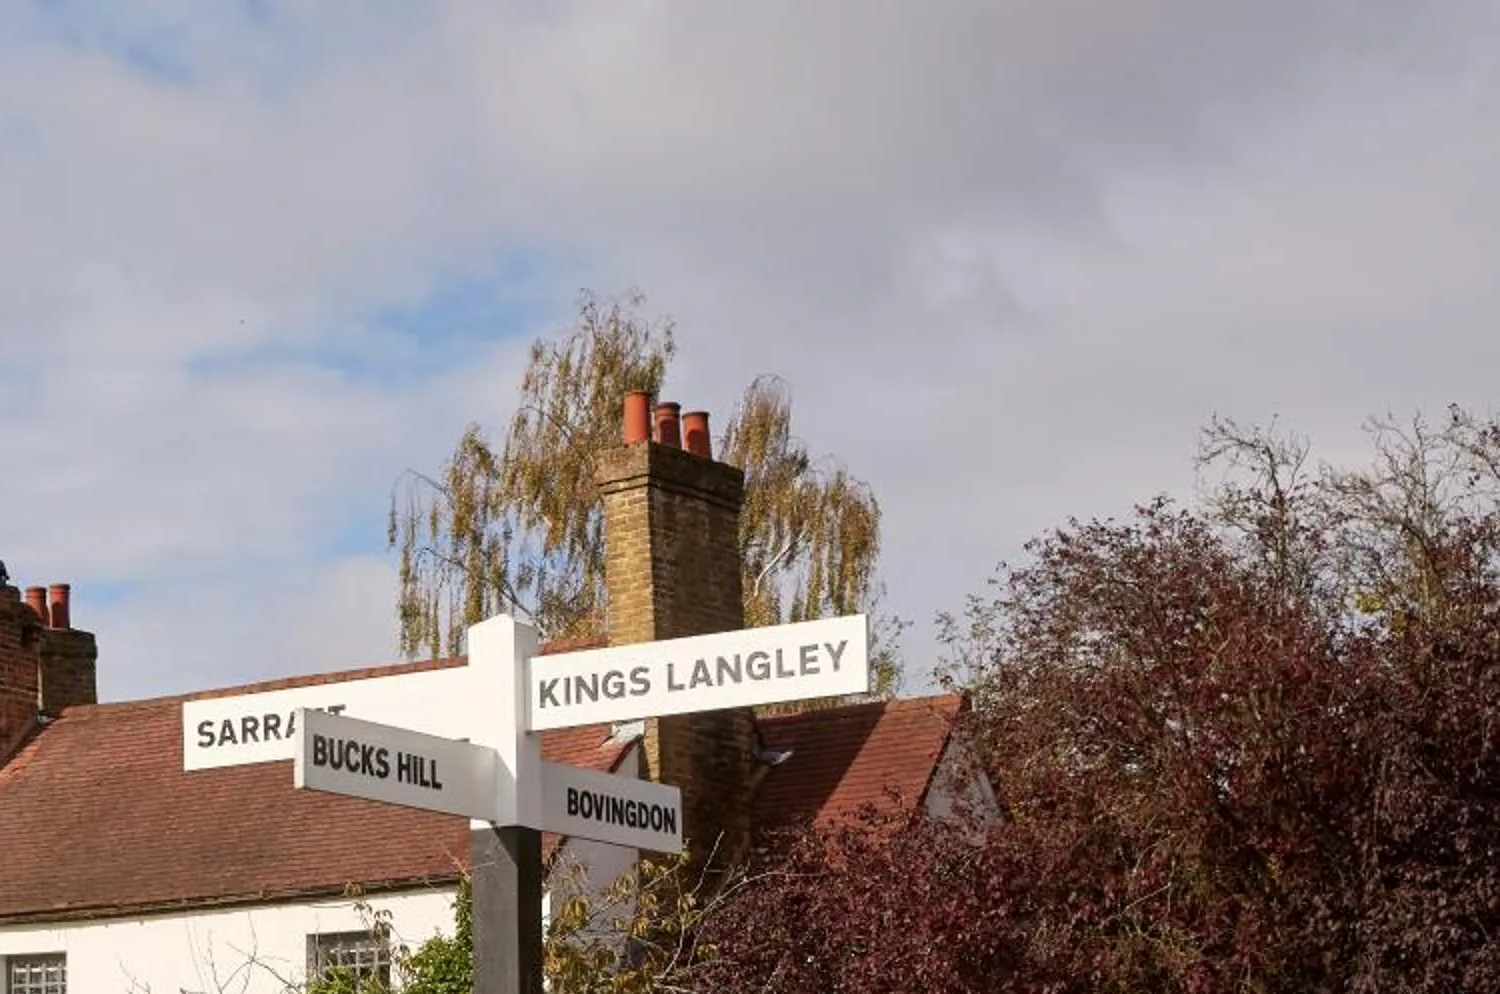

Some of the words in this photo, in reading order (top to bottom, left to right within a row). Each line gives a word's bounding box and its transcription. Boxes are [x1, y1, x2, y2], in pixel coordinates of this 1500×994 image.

[539, 666, 651, 708] KINGS
[666, 639, 848, 692] LANGLEY
[197, 703, 346, 748] SARR
[313, 734, 391, 779] BUCKS
[397, 751, 443, 790] HILL
[567, 787, 677, 835] BOVINGDON
